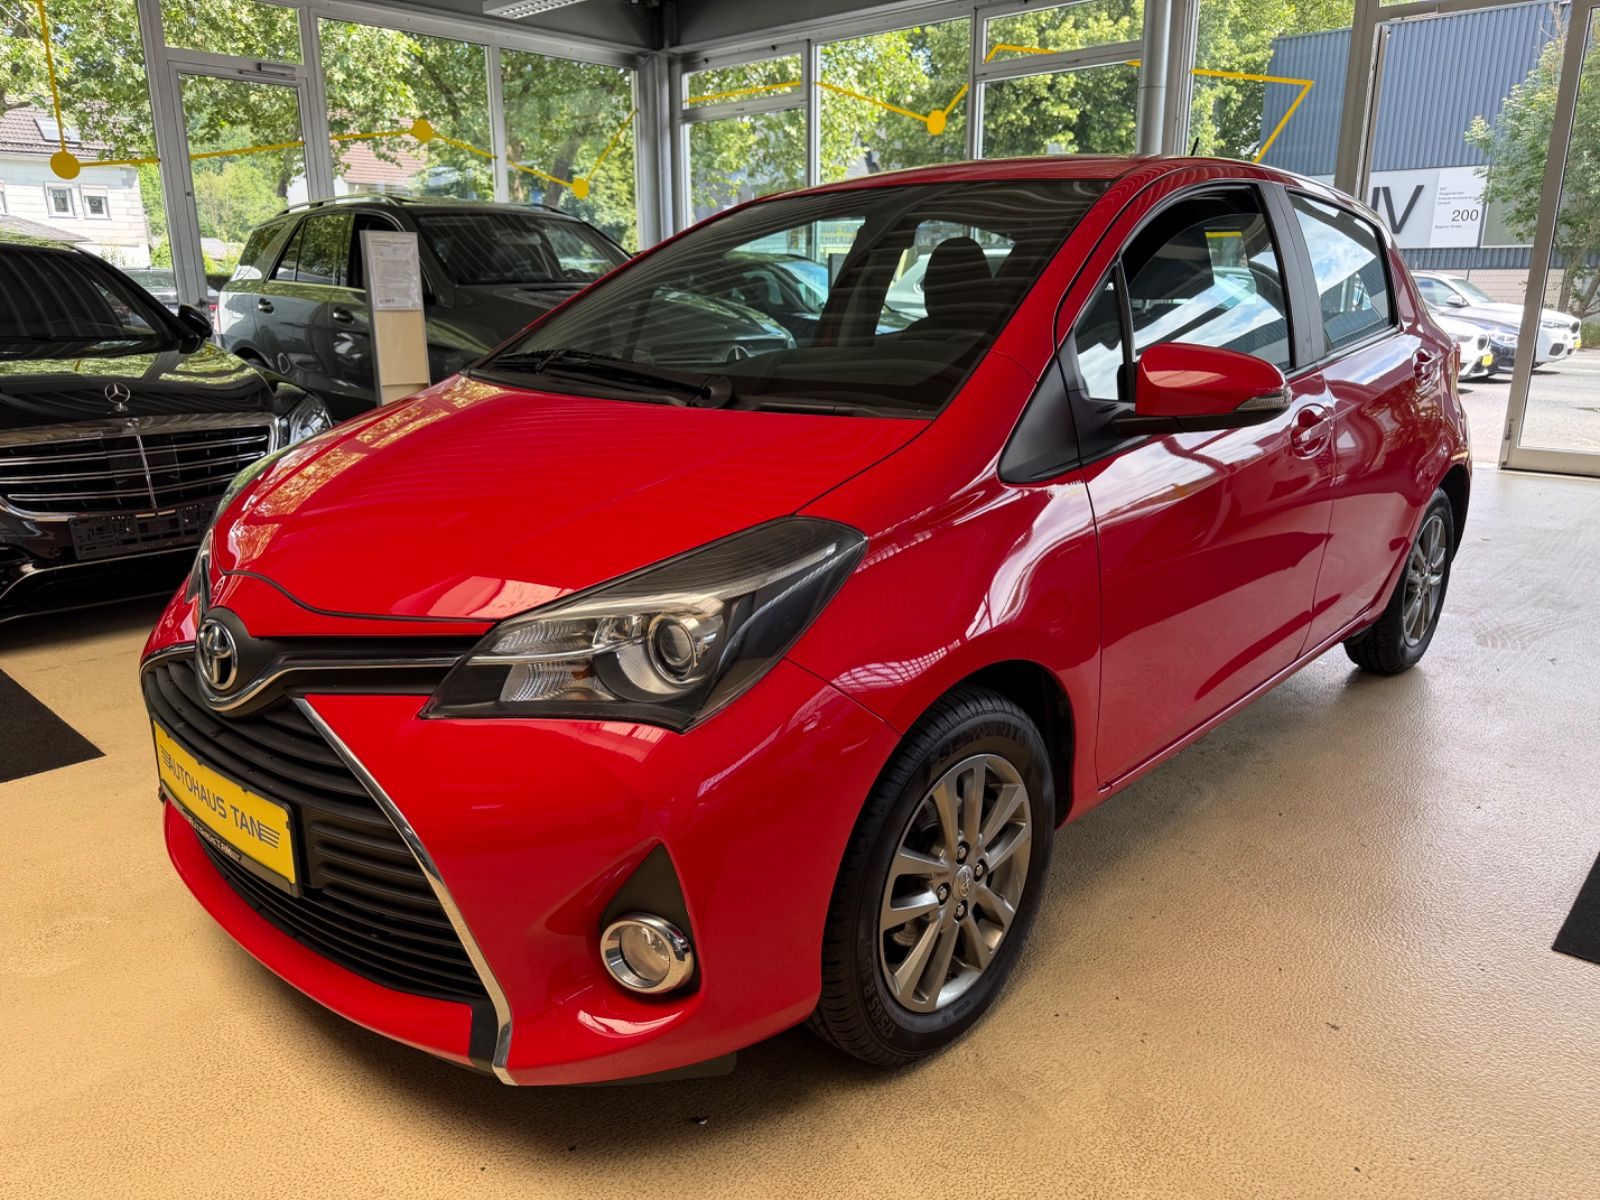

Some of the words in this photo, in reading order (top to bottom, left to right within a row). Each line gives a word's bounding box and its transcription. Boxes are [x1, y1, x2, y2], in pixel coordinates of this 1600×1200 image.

[1451, 209, 1479, 222] 200
[168, 757, 227, 819] AUTOHAUS
[230, 804, 263, 842] TAN
